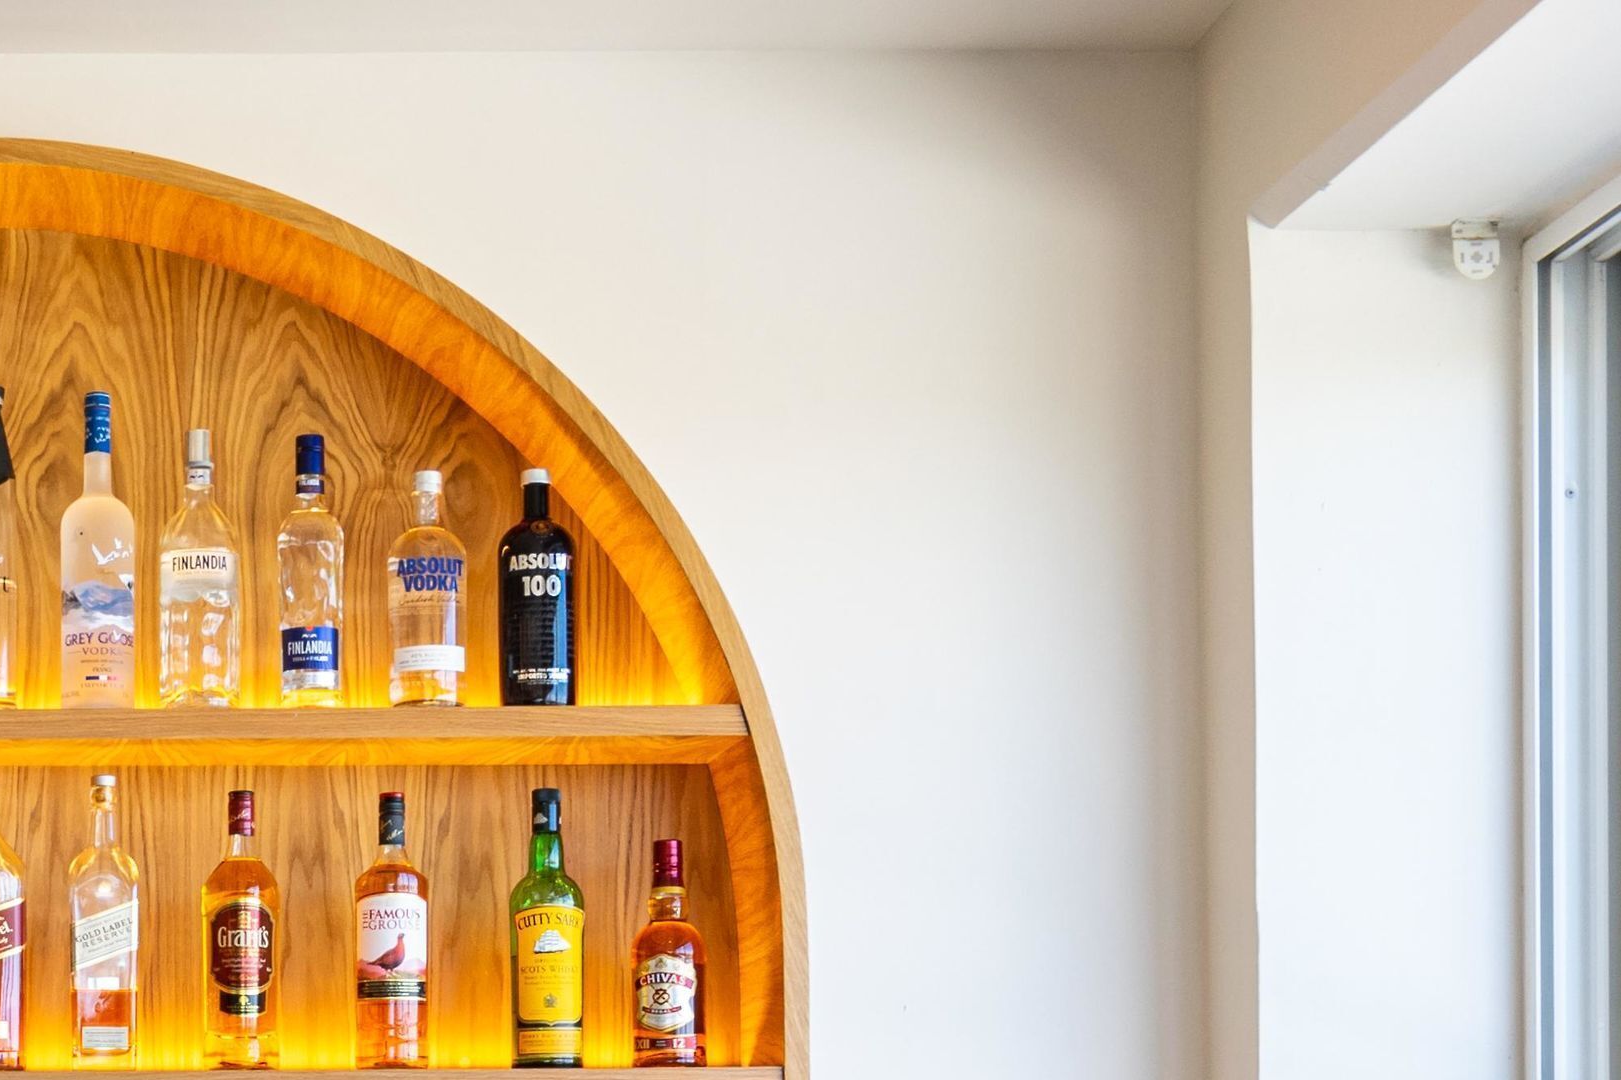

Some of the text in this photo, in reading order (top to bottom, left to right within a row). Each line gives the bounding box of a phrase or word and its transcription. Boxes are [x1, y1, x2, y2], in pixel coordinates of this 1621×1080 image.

[172, 555, 228, 572] FINLANDIA
[397, 556, 464, 577] ABSOLUT
[509, 553, 572, 572] ABSOLUT
[402, 575, 459, 593] VODKA
[521, 575, 562, 597] 100
[64, 631, 134, 648] GREY GOOS
[287, 640, 333, 656] FINLANDIA
[81, 647, 122, 656] VODK
[369, 908, 421, 920] FAMOUS
[518, 912, 551, 931] CUTTY
[76, 928, 101, 943] GOLD
[103, 917, 133, 934] LABEL
[369, 919, 421, 931] GROUSE
[217, 924, 269, 949] Grant's
[640, 971, 686, 986] CHIVAS
[636, 1039, 650, 1049] XII
[672, 1038, 686, 1048] 12
